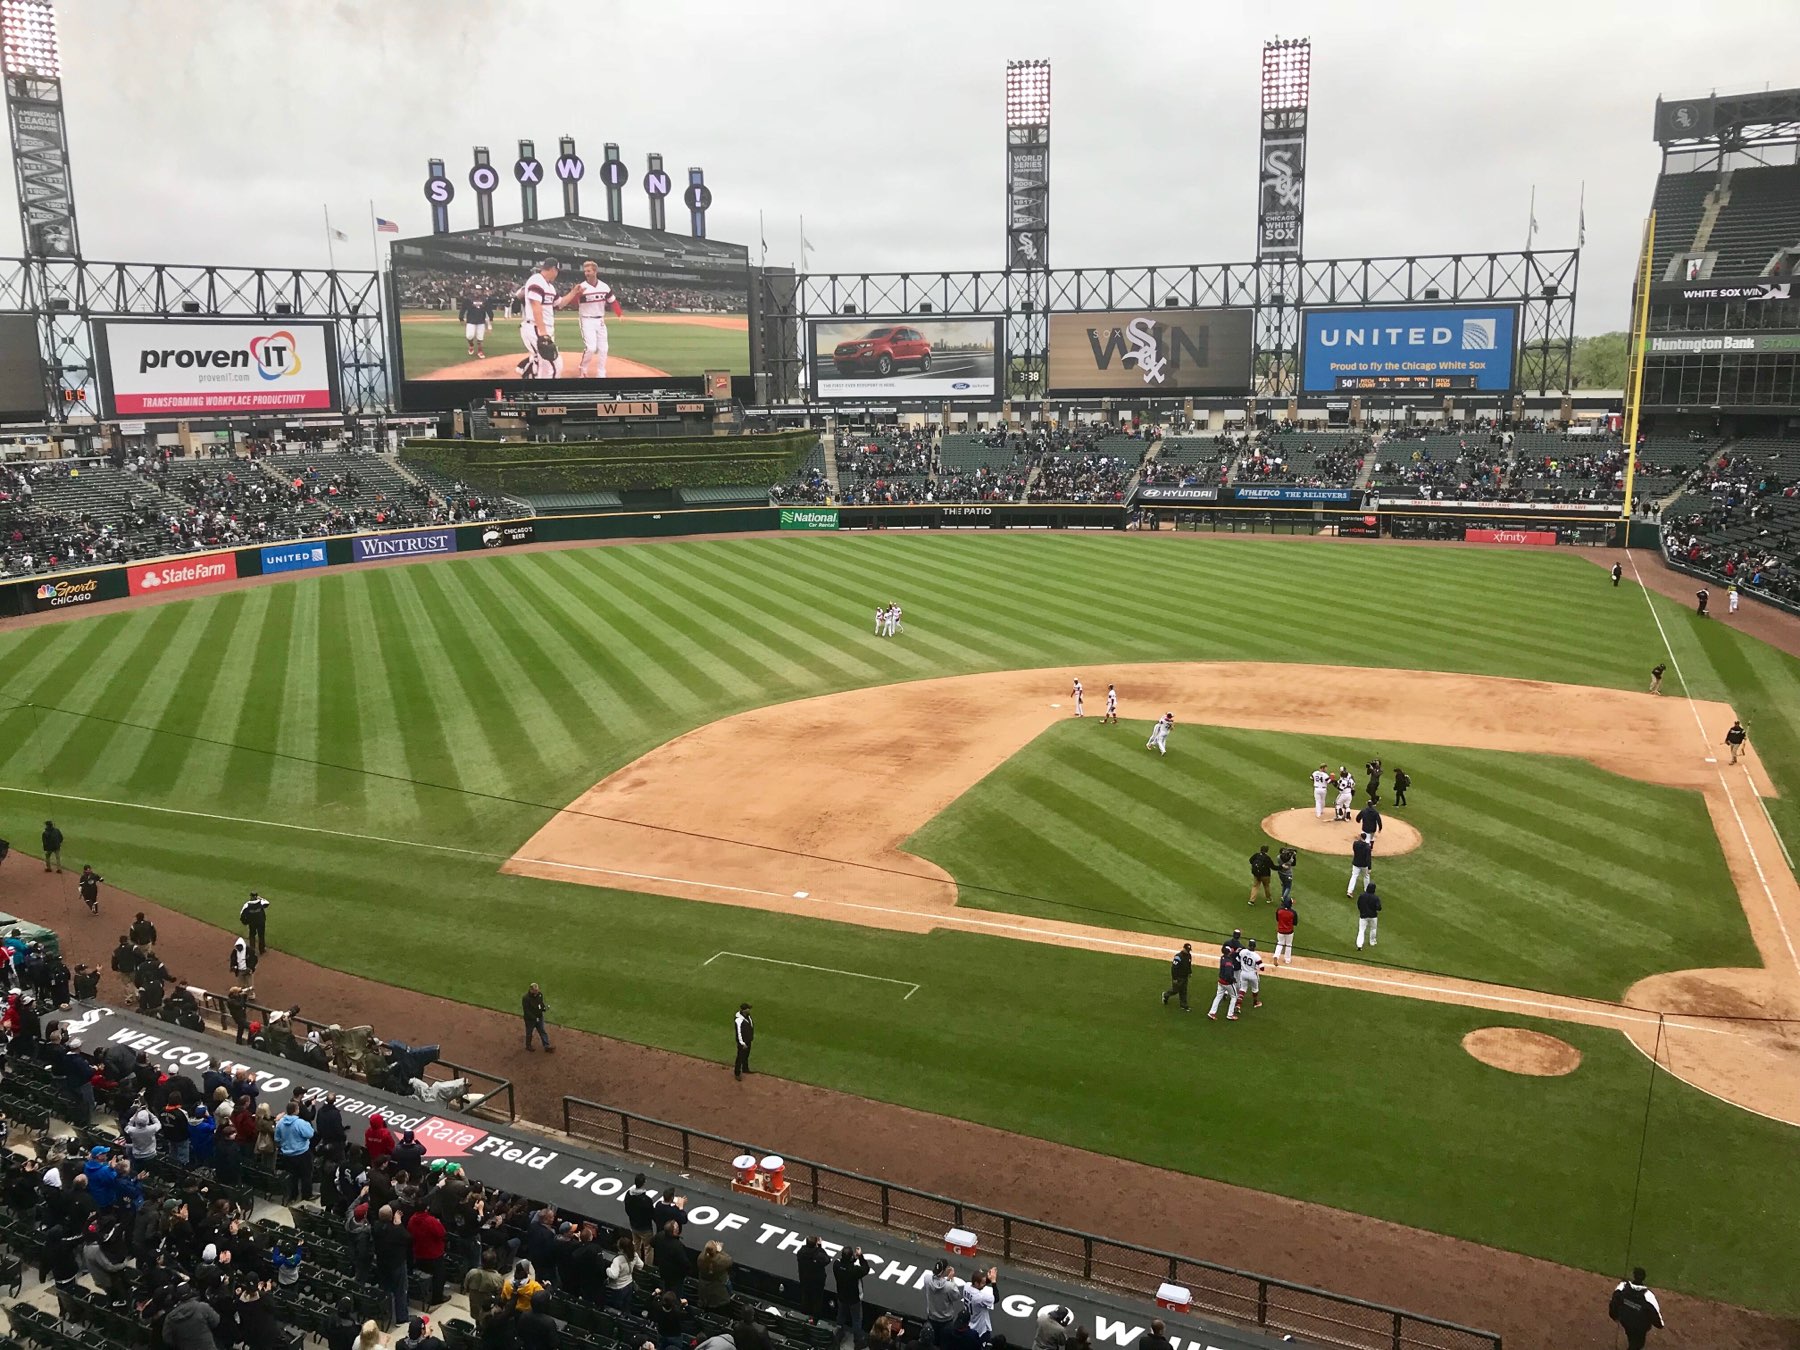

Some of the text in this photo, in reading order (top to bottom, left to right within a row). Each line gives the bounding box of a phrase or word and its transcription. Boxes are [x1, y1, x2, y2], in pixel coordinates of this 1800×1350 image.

[19, 116, 57, 127] LEAGUE
[1013, 154, 1043, 162] WORLD
[1013, 161, 1043, 169] SERIES
[1265, 221, 1296, 229] WHITE
[1265, 228, 1295, 240] SOX
[1683, 289, 1718, 298] WHITE
[1720, 288, 1741, 297] SOX
[1093, 329, 1121, 339] SOX
[1320, 327, 1453, 347] UNITED
[1652, 338, 1722, 353] Huntington
[1723, 336, 1755, 349] Bank
[140, 346, 287, 373] proven IT
[1330, 361, 1487, 372] Proud to fly the Chicago White Sox
[198, 373, 250, 384] provenIT.com
[1020, 371, 1039, 381] 3:38
[143, 394, 306, 408] TRANSFORMING WORKPLACE PRODUCTIVITY
[603, 404, 653, 414] WIN
[1163, 490, 1213, 498] HYUNDAI
[1238, 488, 1280, 497] ATHLETICO
[1301, 491, 1348, 499] RELIEVERS
[964, 507, 992, 515] PATIO
[793, 511, 837, 522] National
[504, 526, 533, 535] CHICAGO'S
[1493, 531, 1527, 544] xfinity
[361, 535, 448, 555] WINTRUST
[266, 552, 310, 564] UNITED
[55, 578, 98, 597] Sports
[51, 592, 92, 606] CHICAGO
[1315, 775, 1323, 783] 24
[1242, 955, 1253, 967] 40
[416, 1118, 476, 1147] Rate
[472, 1136, 558, 1170] Field
[560, 1168, 680, 1208] HO
[687, 1205, 750, 1232] OF
[764, 1174, 771, 1182] G
[953, 1246, 961, 1255] G
[1166, 1303, 1176, 1312] G
